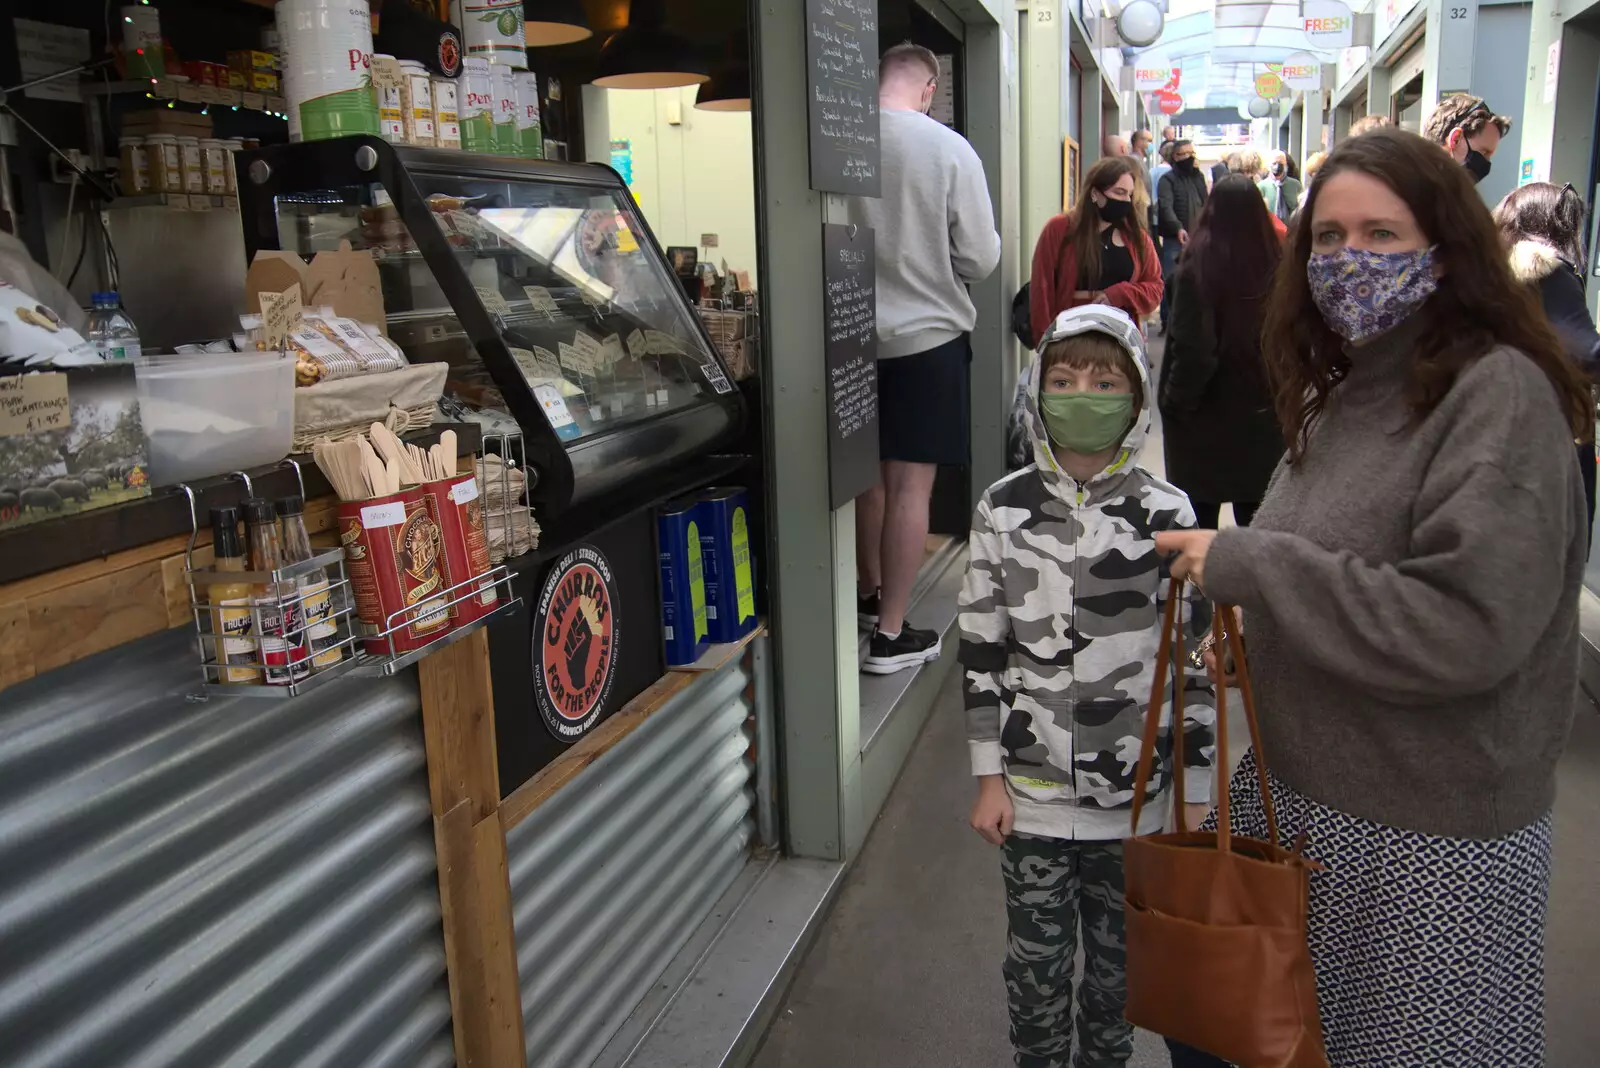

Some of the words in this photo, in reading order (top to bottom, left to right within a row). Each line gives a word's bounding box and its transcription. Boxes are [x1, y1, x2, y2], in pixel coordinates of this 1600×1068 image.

[1037, 10, 1053, 23] 23
[1450, 7, 1468, 20] 32
[1304, 16, 1351, 32] FRESH
[1136, 68, 1170, 80] FRESH
[1282, 65, 1319, 78] FRESH
[539, 567, 562, 617] SPANISH
[559, 551, 574, 572] DELI
[578, 548, 599, 563] STREET
[597, 557, 612, 583] FOOD
[547, 571, 609, 647] CHURROS
[548, 662, 565, 705] FOR
[565, 691, 584, 713] THE
[584, 635, 610, 706] PEOPLE
[559, 722, 584, 737] NORWICH
[583, 703, 602, 731] MARKET
